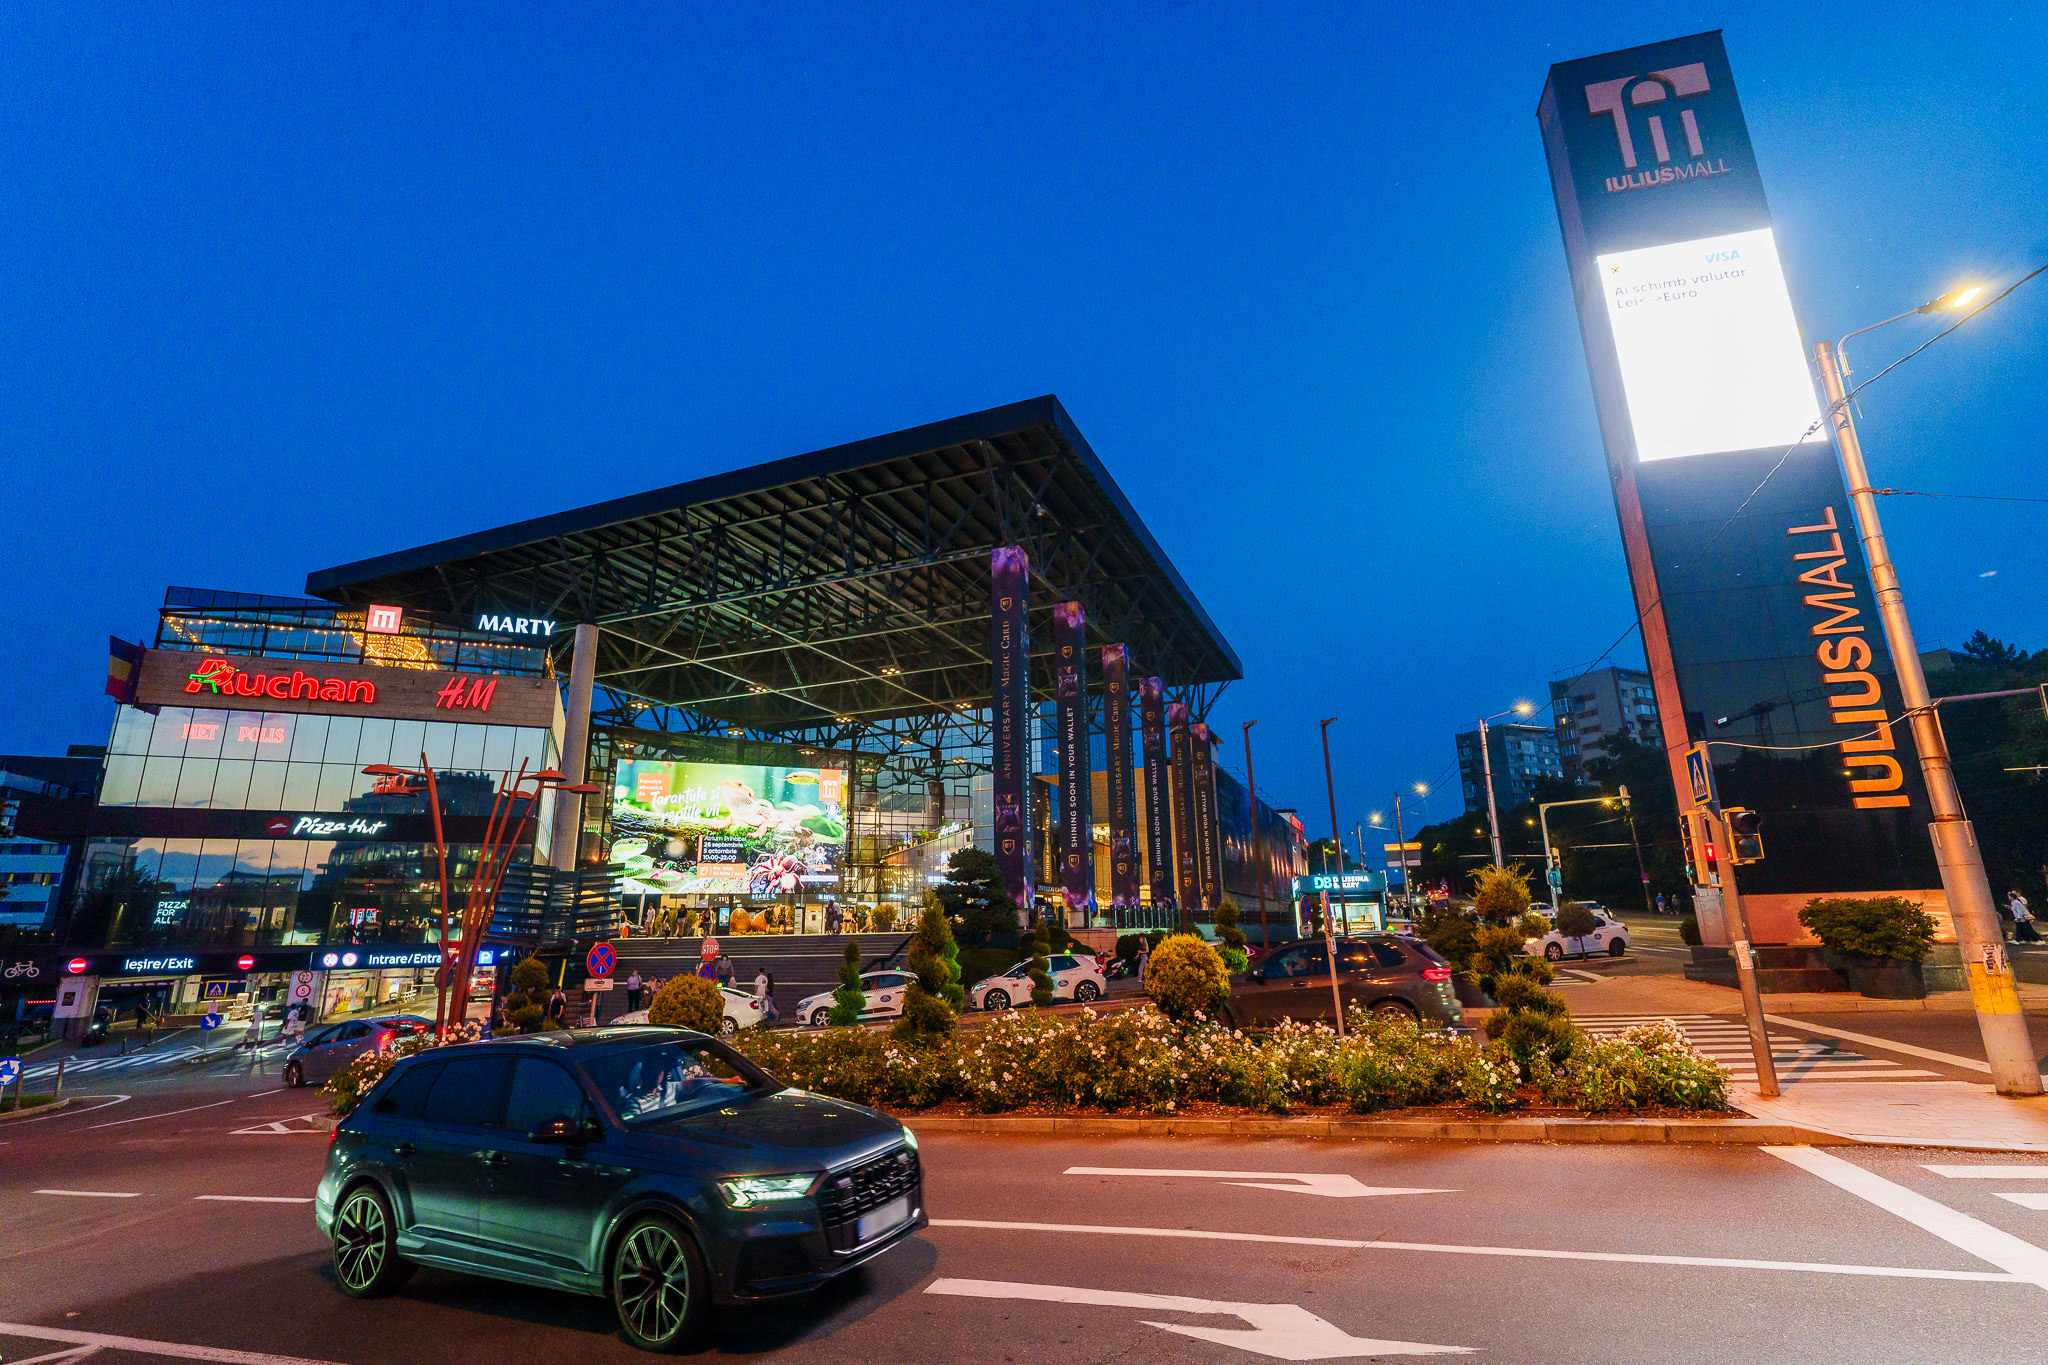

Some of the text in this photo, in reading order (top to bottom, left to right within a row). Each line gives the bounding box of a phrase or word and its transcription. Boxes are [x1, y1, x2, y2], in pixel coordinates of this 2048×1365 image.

[1705, 249, 1741, 264] VISA
[1632, 277, 1687, 293] schimb
[1691, 268, 1745, 285] valutar
[478, 614, 556, 636] MARTY
[1786, 506, 1911, 809] IULIUSMALL
[185, 657, 376, 704] Auchan
[435, 675, 497, 712] H&M
[1066, 707, 1074, 741] WALLET
[1069, 771, 1076, 780] IN
[1069, 782, 1077, 808] SOON
[1154, 806, 1160, 814] IN
[293, 816, 387, 835] Pizza Hut
[1070, 810, 1078, 848] SHINING
[156, 908, 175, 917] FOR
[158, 901, 187, 909] PIZZA
[153, 916, 171, 925] ALL
[701, 944, 720, 955] STOP
[125, 957, 194, 972] Ieșire/Exit
[368, 953, 442, 966] Intrare/Entra
